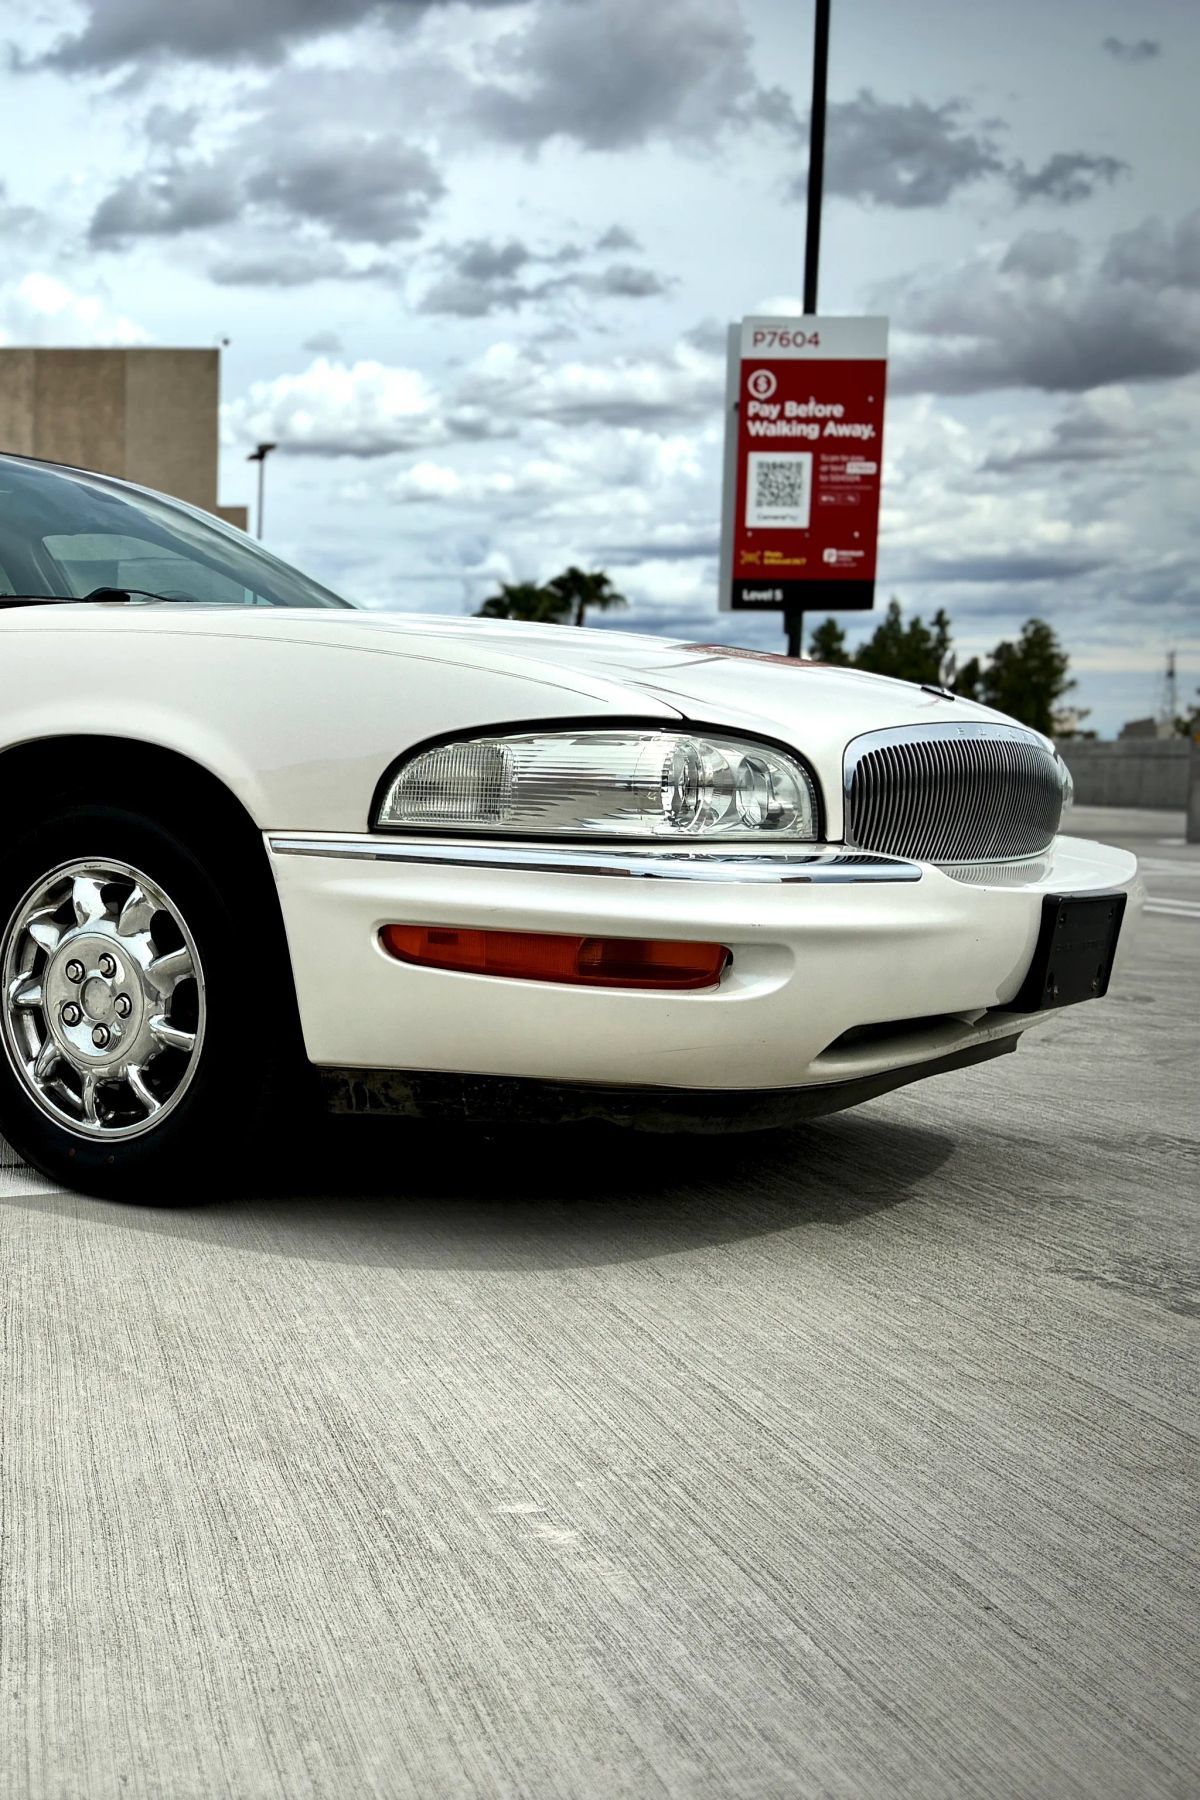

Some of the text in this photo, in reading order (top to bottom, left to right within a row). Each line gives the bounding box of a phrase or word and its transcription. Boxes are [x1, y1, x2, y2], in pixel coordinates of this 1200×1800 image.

[753, 331, 820, 347] P7604
[748, 400, 844, 419] Pay Before
[747, 420, 876, 440] Walking Away.
[742, 588, 773, 601] Level
